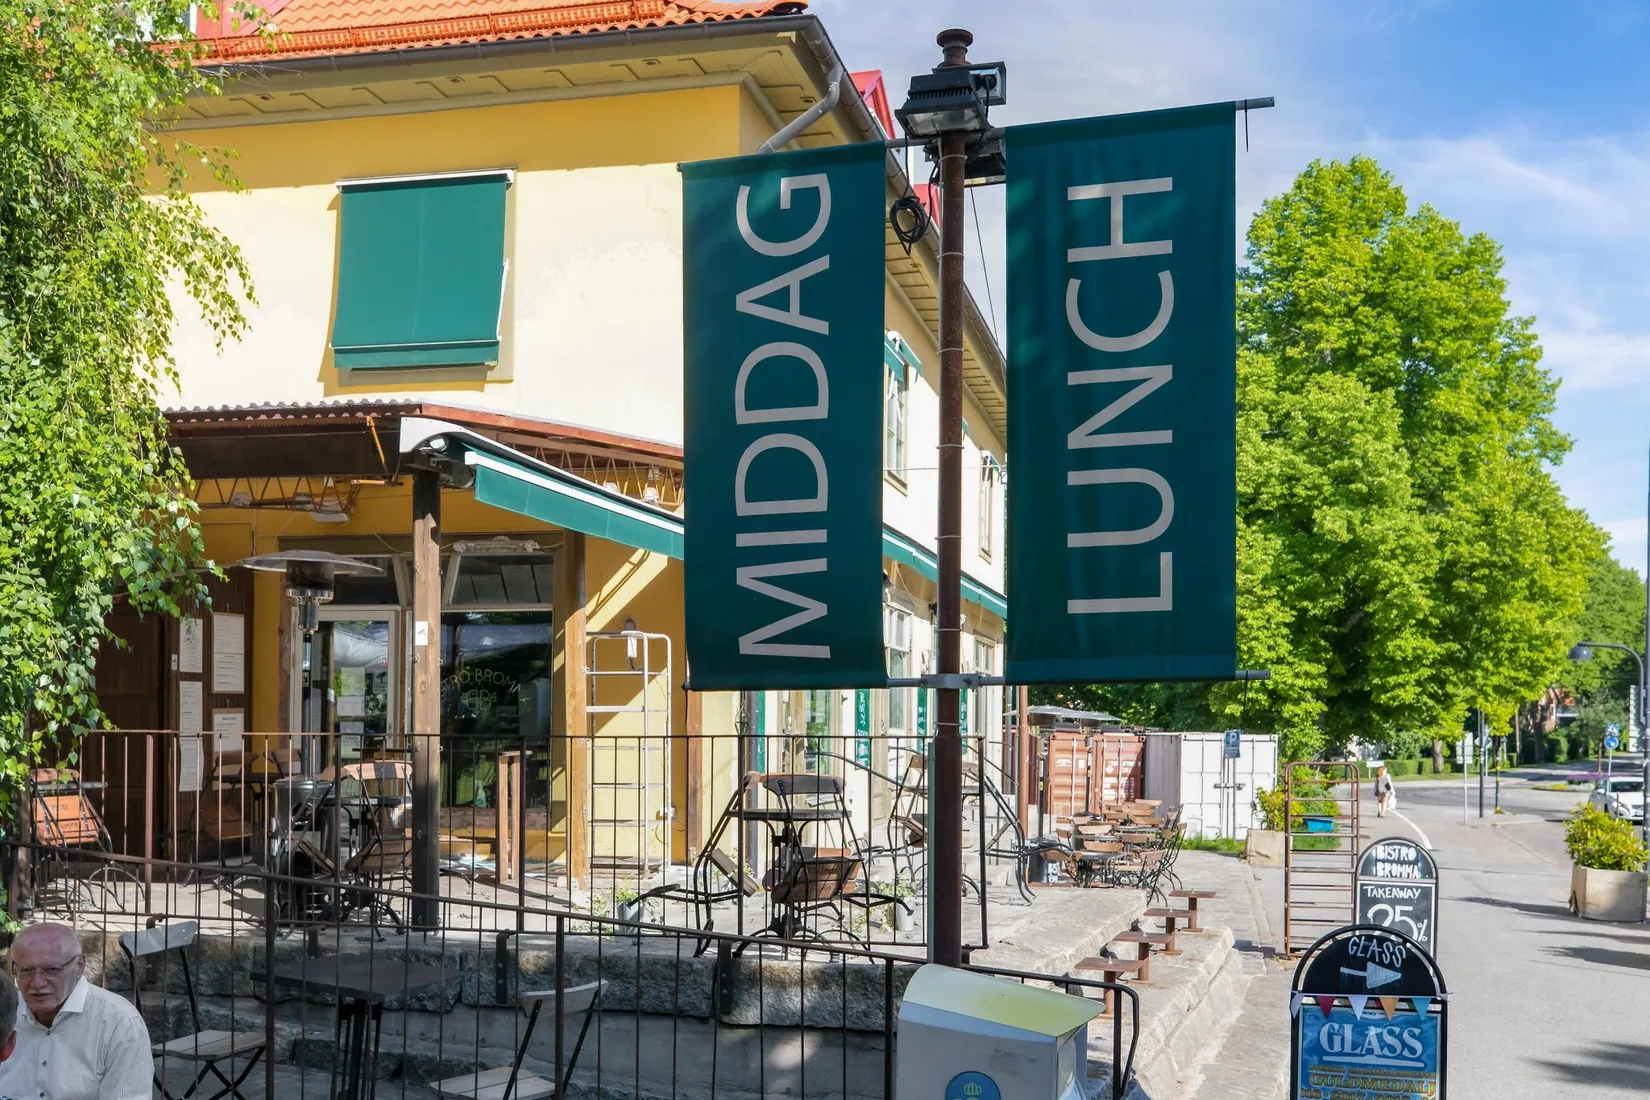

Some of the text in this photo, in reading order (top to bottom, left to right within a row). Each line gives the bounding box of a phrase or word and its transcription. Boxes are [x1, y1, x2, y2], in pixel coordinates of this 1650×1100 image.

[1065, 176, 1175, 614] LUNCH
[735, 172, 832, 659] MIDDAG
[1376, 845, 1418, 861] BISTRO
[1376, 862, 1420, 879] BROMMA
[1363, 885, 1421, 900] TAKEAWAY
[1348, 935, 1406, 968] GLASS
[1319, 1022, 1423, 1059] GLASS
